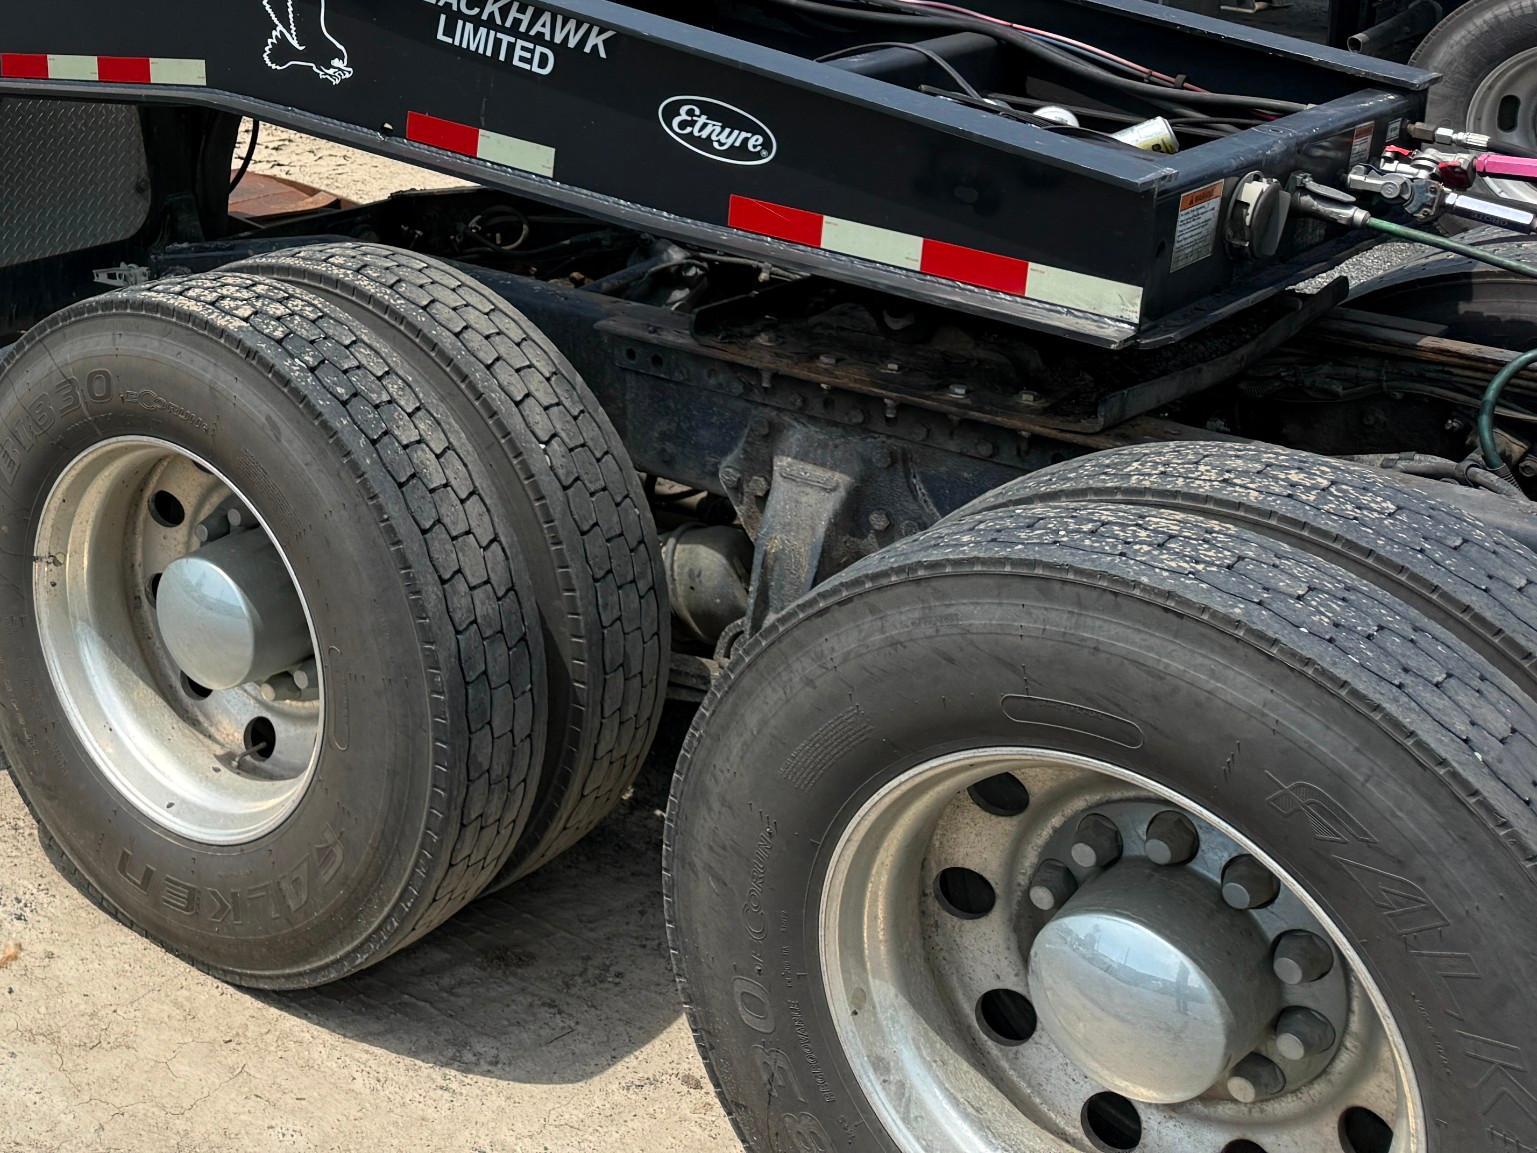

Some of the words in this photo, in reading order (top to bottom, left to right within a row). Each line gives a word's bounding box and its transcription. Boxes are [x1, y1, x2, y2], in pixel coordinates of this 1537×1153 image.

[436, 13, 555, 76] LIMITED
[671, 104, 765, 153] Etnyre
[116, 822, 345, 925] FALKEN
